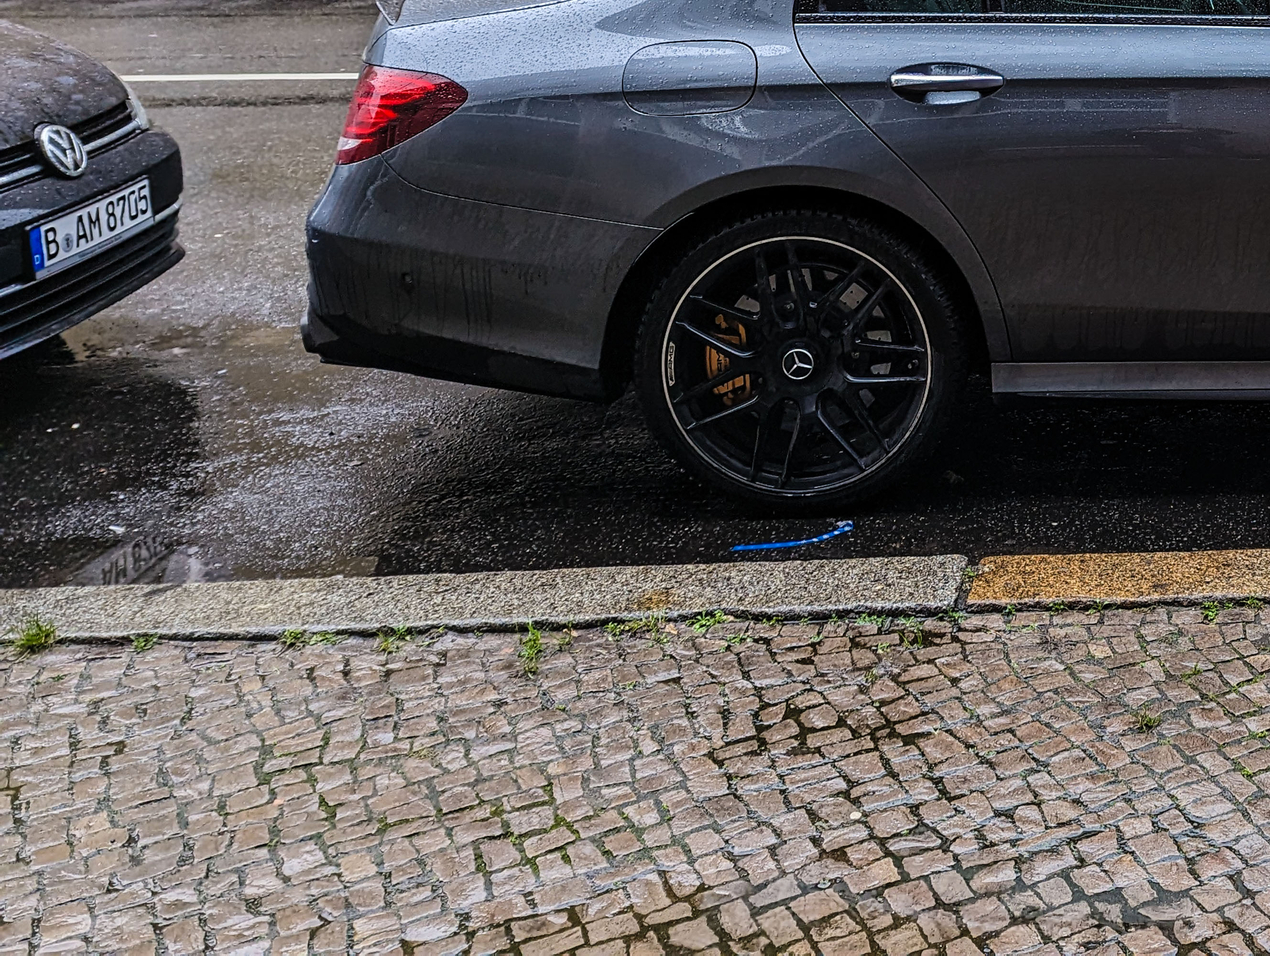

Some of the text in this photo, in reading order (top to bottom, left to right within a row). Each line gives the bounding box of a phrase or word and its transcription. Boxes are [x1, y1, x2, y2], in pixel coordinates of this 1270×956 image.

[44, 225, 60, 262] B
[75, 206, 103, 249] AM
[105, 184, 150, 233] 8705
